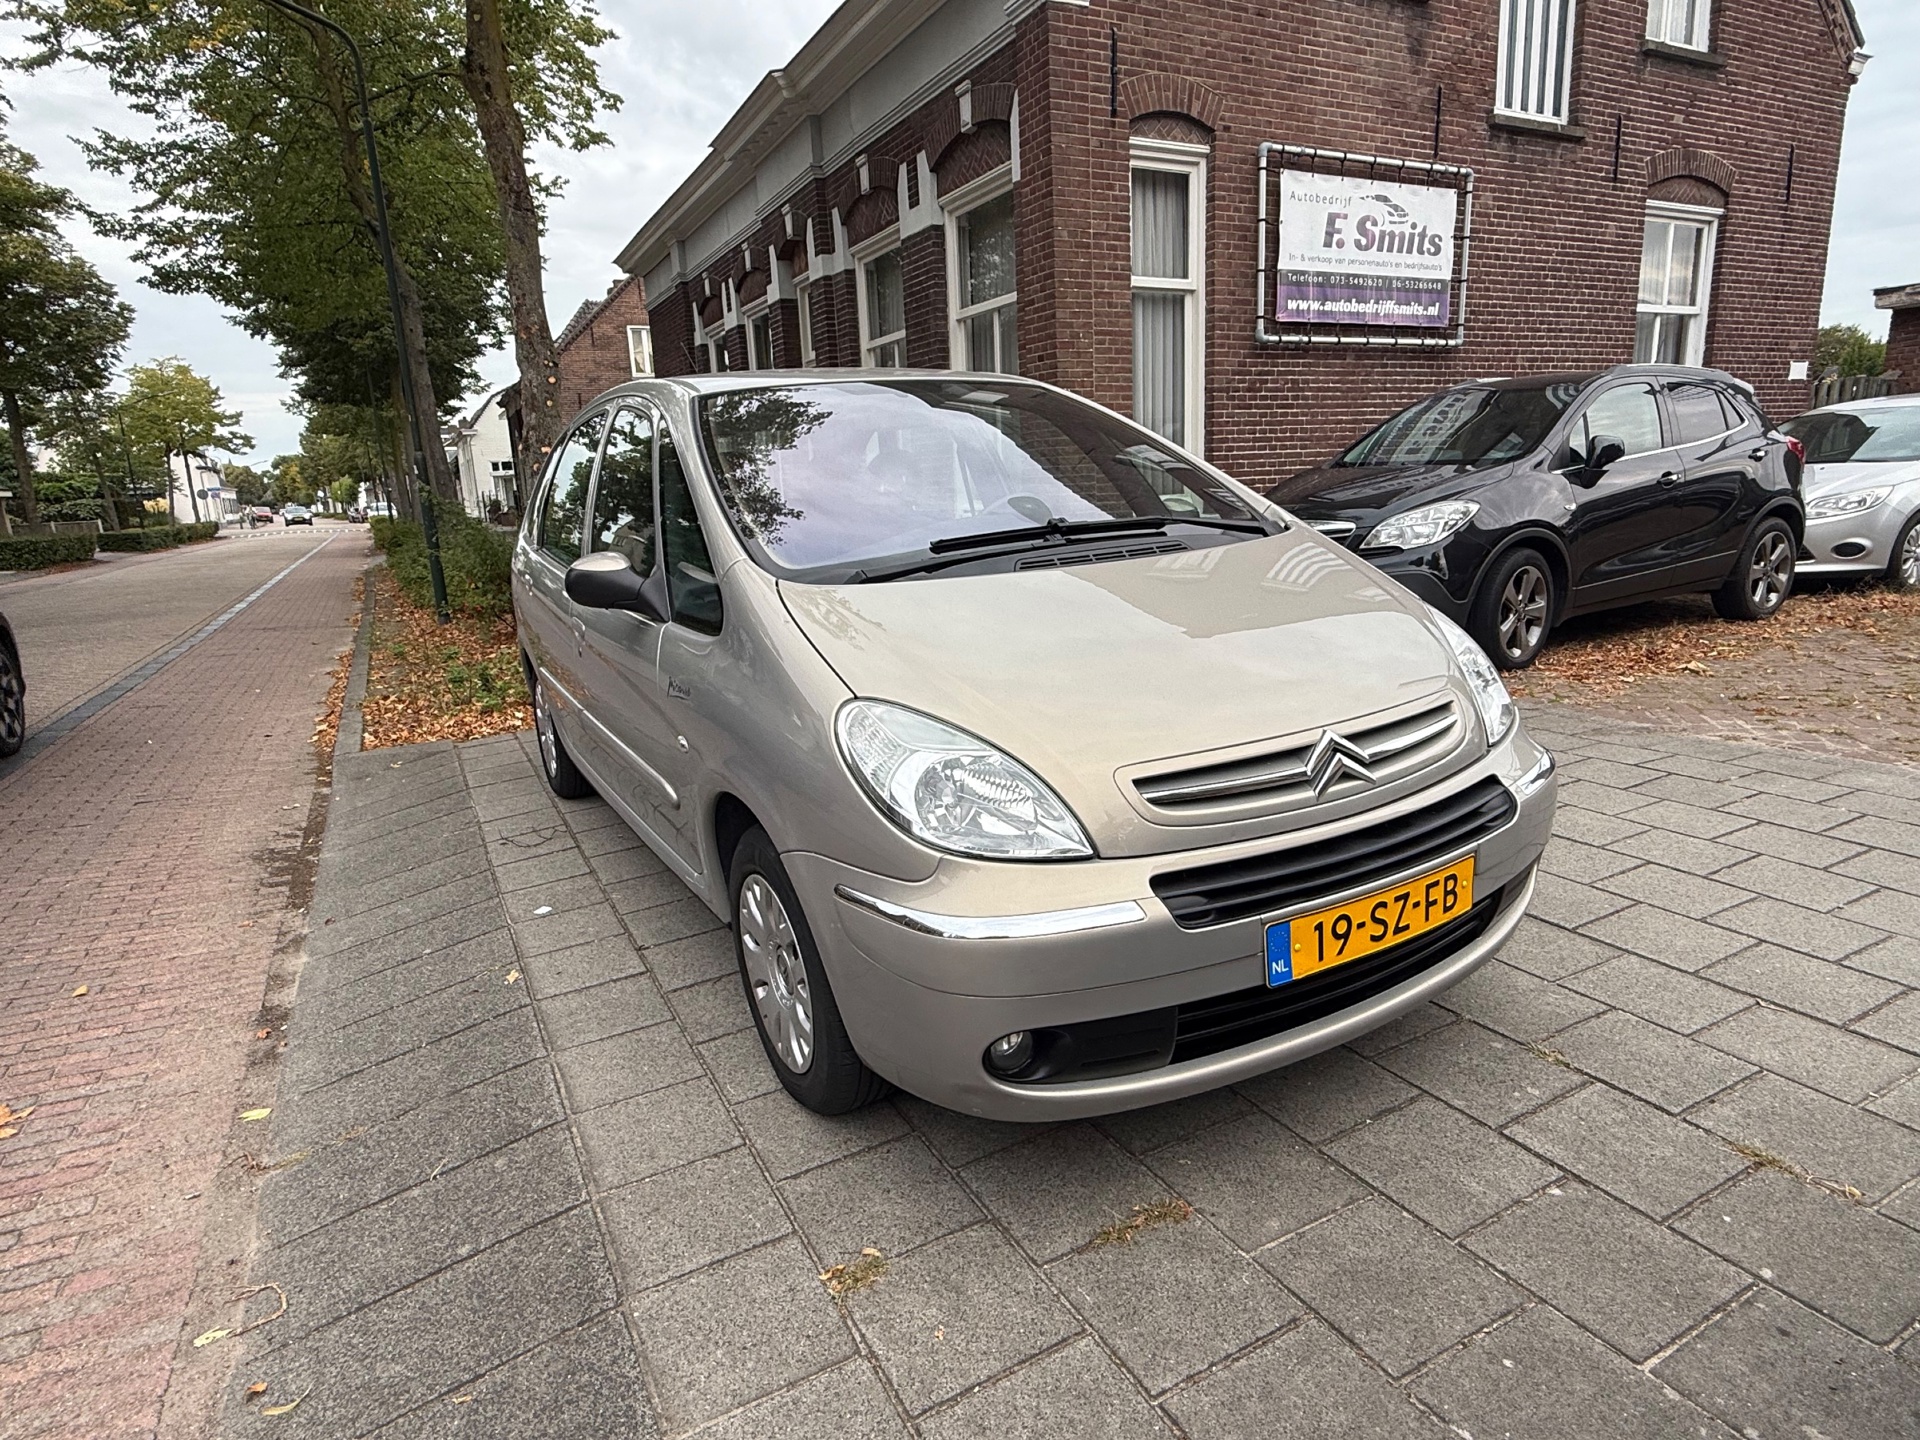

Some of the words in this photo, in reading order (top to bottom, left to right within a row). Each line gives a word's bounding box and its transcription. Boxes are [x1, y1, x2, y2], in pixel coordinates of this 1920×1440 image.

[1290, 190, 1352, 208] Autobedrijf
[1323, 212, 1348, 249] F.
[1354, 214, 1443, 257] Smits
[1289, 253, 1299, 261] In-
[1301, 253, 1306, 262] &
[1308, 254, 1332, 265] verkoop
[1335, 257, 1346, 265] van
[1348, 258, 1393, 268] personenauto's
[1404, 261, 1442, 271] bedrijfsauto's
[1288, 273, 1326, 283] Telefoon:
[1330, 275, 1383, 287] 073-5492620
[1288, 298, 1440, 316] www.autobedrijffsmits.nl
[1313, 872, 1459, 962] 19-SZ-FB
[1272, 959, 1289, 975] NL
